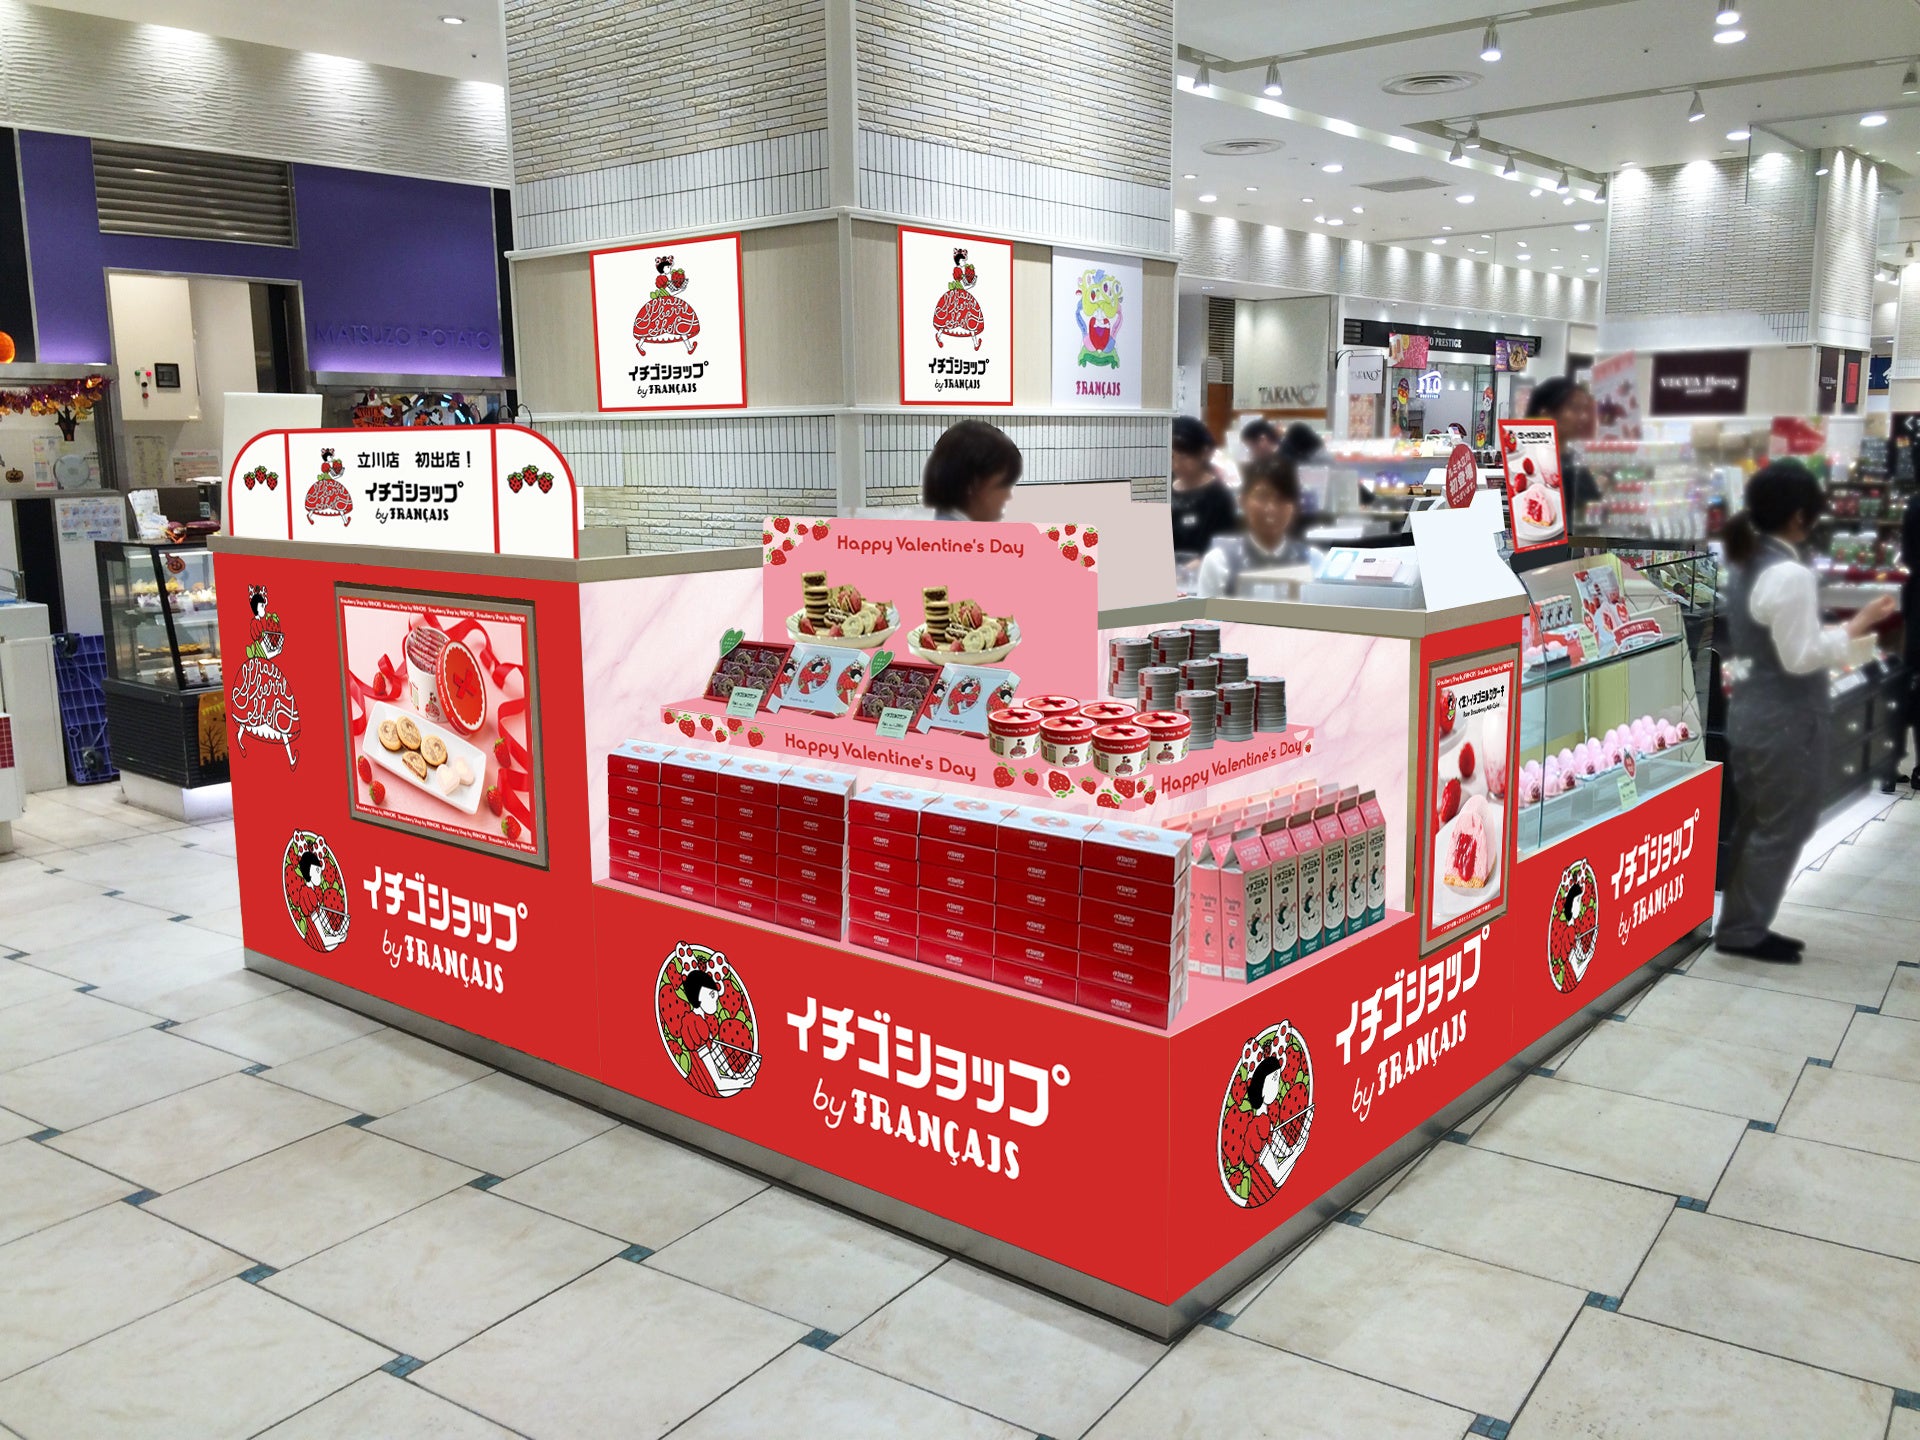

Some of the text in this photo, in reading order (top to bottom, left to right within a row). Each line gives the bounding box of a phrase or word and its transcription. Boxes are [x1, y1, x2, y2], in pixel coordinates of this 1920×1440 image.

[315, 324, 492, 350] MATSUZO POTATO
[1435, 337, 1463, 348] PRESTIGE
[629, 361, 710, 381] イチゴショップ
[928, 357, 990, 375] イチゴショップ
[637, 386, 649, 398] by
[934, 379, 944, 392] by
[357, 450, 471, 469] 立川店 初出店！
[365, 481, 464, 503] イチゴショップ
[1449, 463, 1474, 496] 初登場
[375, 508, 389, 524] by
[837, 535, 1025, 558] Happy Valentine's Day
[785, 732, 976, 781] Happy Valentine's Day
[1161, 740, 1303, 794] Happy Valentine's Day
[1611, 808, 1699, 900] イチゴショップ
[363, 866, 528, 952] イチゴショップ
[1618, 873, 1685, 945] by FRANÇAIS
[382, 929, 504, 994] by FRANÇAIS
[1336, 924, 1490, 1065] イチゴショップ
[786, 997, 1071, 1127] イチゴショップ
[1352, 1009, 1467, 1122] by FRANÇAIS
[813, 1078, 1021, 1180] by FRANÇAIS
